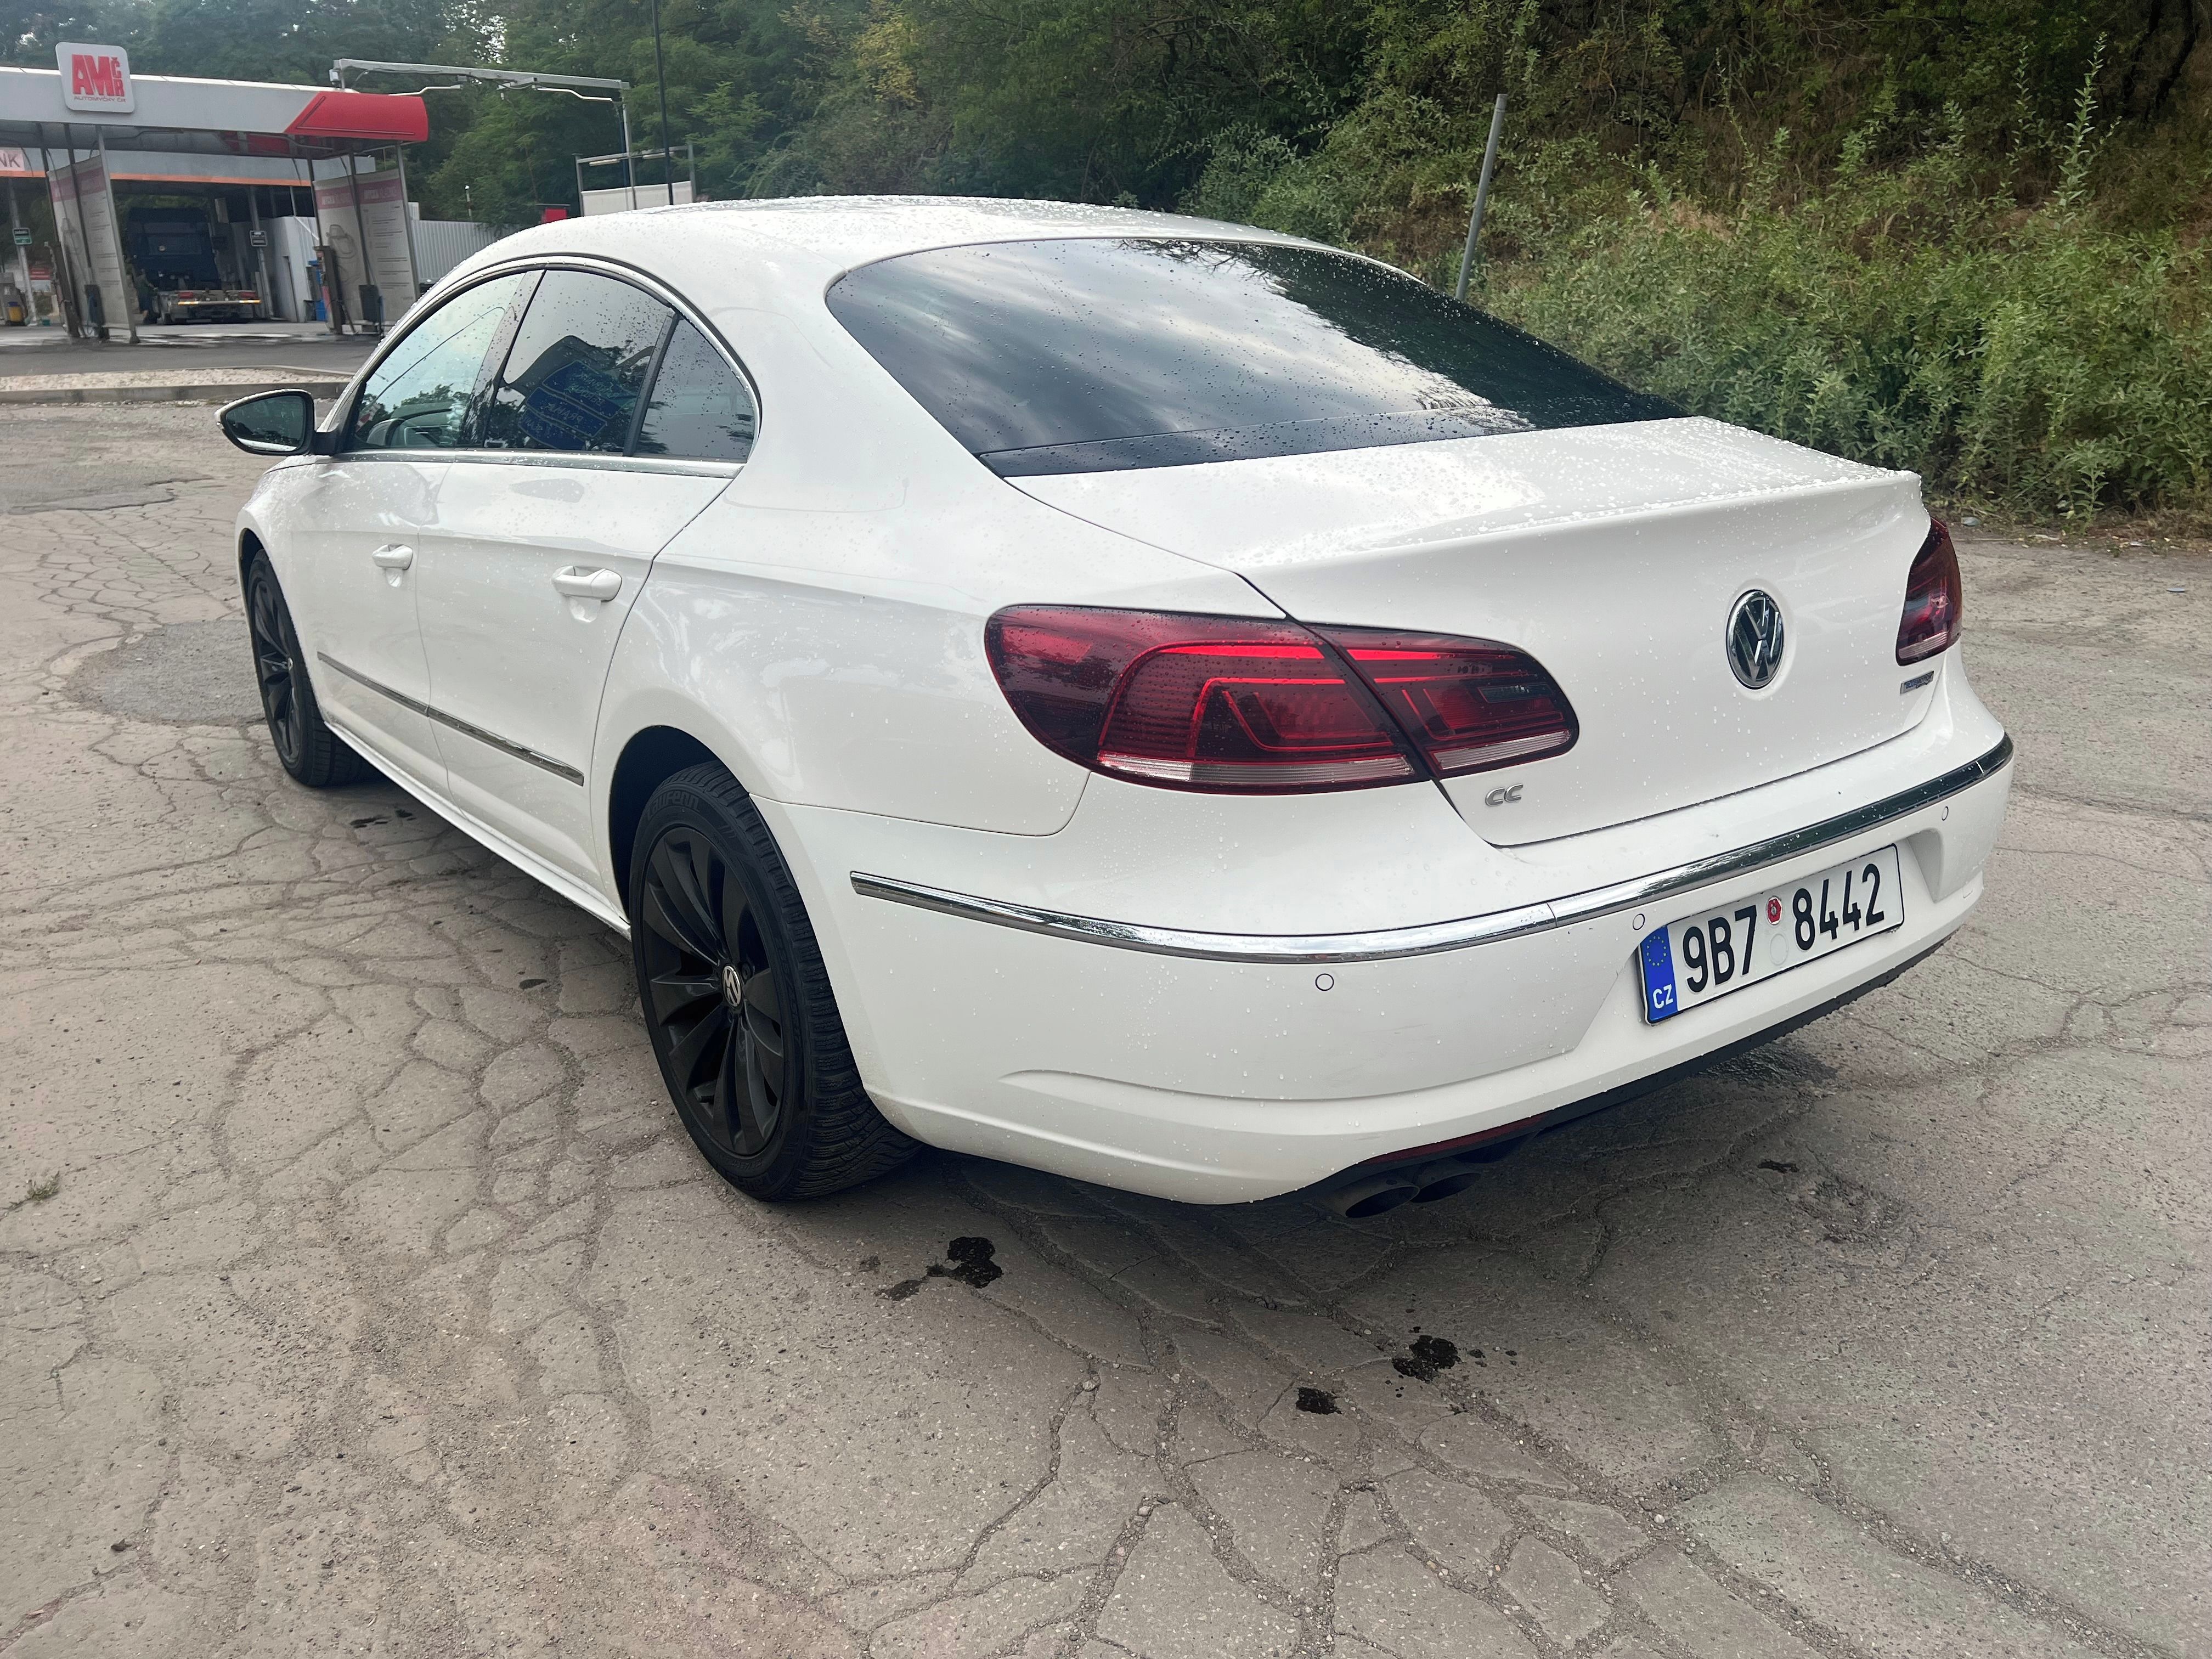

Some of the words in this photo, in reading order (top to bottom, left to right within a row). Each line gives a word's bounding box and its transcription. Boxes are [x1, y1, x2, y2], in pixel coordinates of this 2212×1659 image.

[1485, 782, 1523, 807] CC
[1682, 904, 1757, 993] 9B7
[1792, 863, 1885, 951] 8442
[1652, 984, 1673, 1009] CZ
